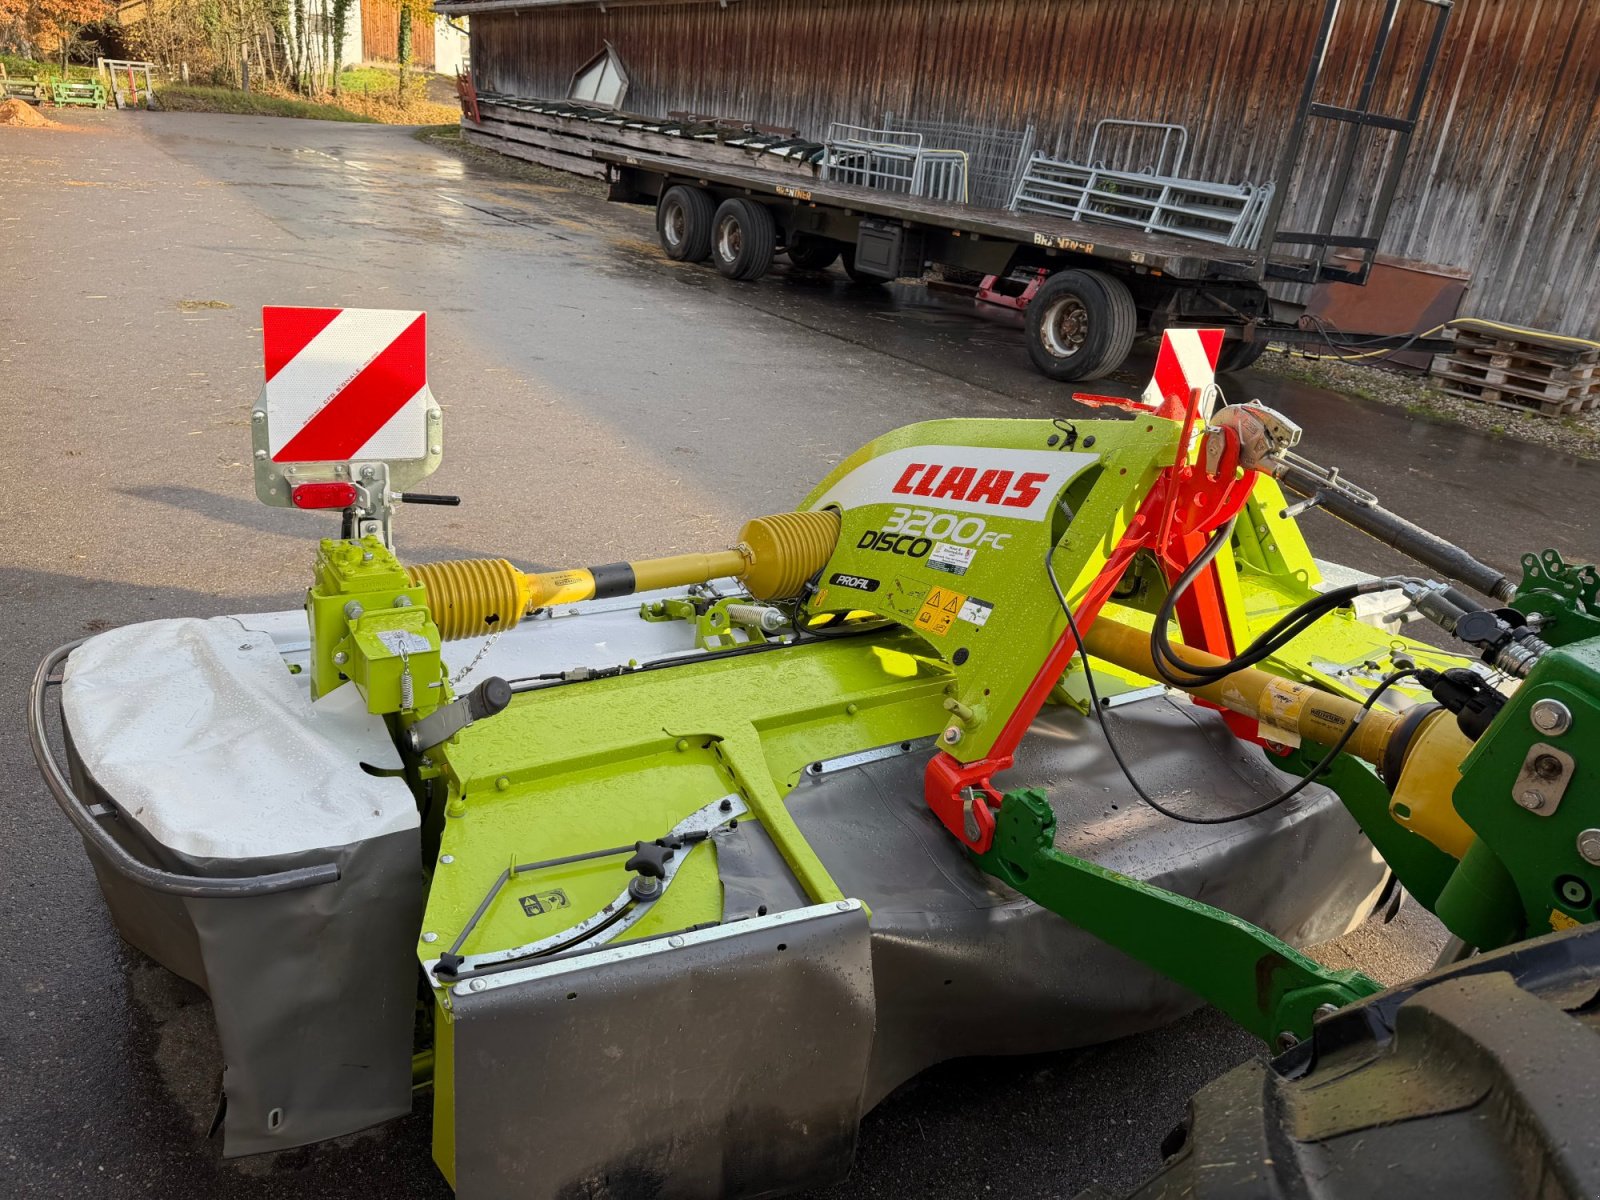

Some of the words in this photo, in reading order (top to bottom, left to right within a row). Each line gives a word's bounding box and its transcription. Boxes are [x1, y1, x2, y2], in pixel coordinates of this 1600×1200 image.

[892, 463, 1050, 508] CLAAS
[881, 507, 987, 544] 3200
[857, 530, 933, 558] DISCO
[835, 575, 870, 590] PROFIL
